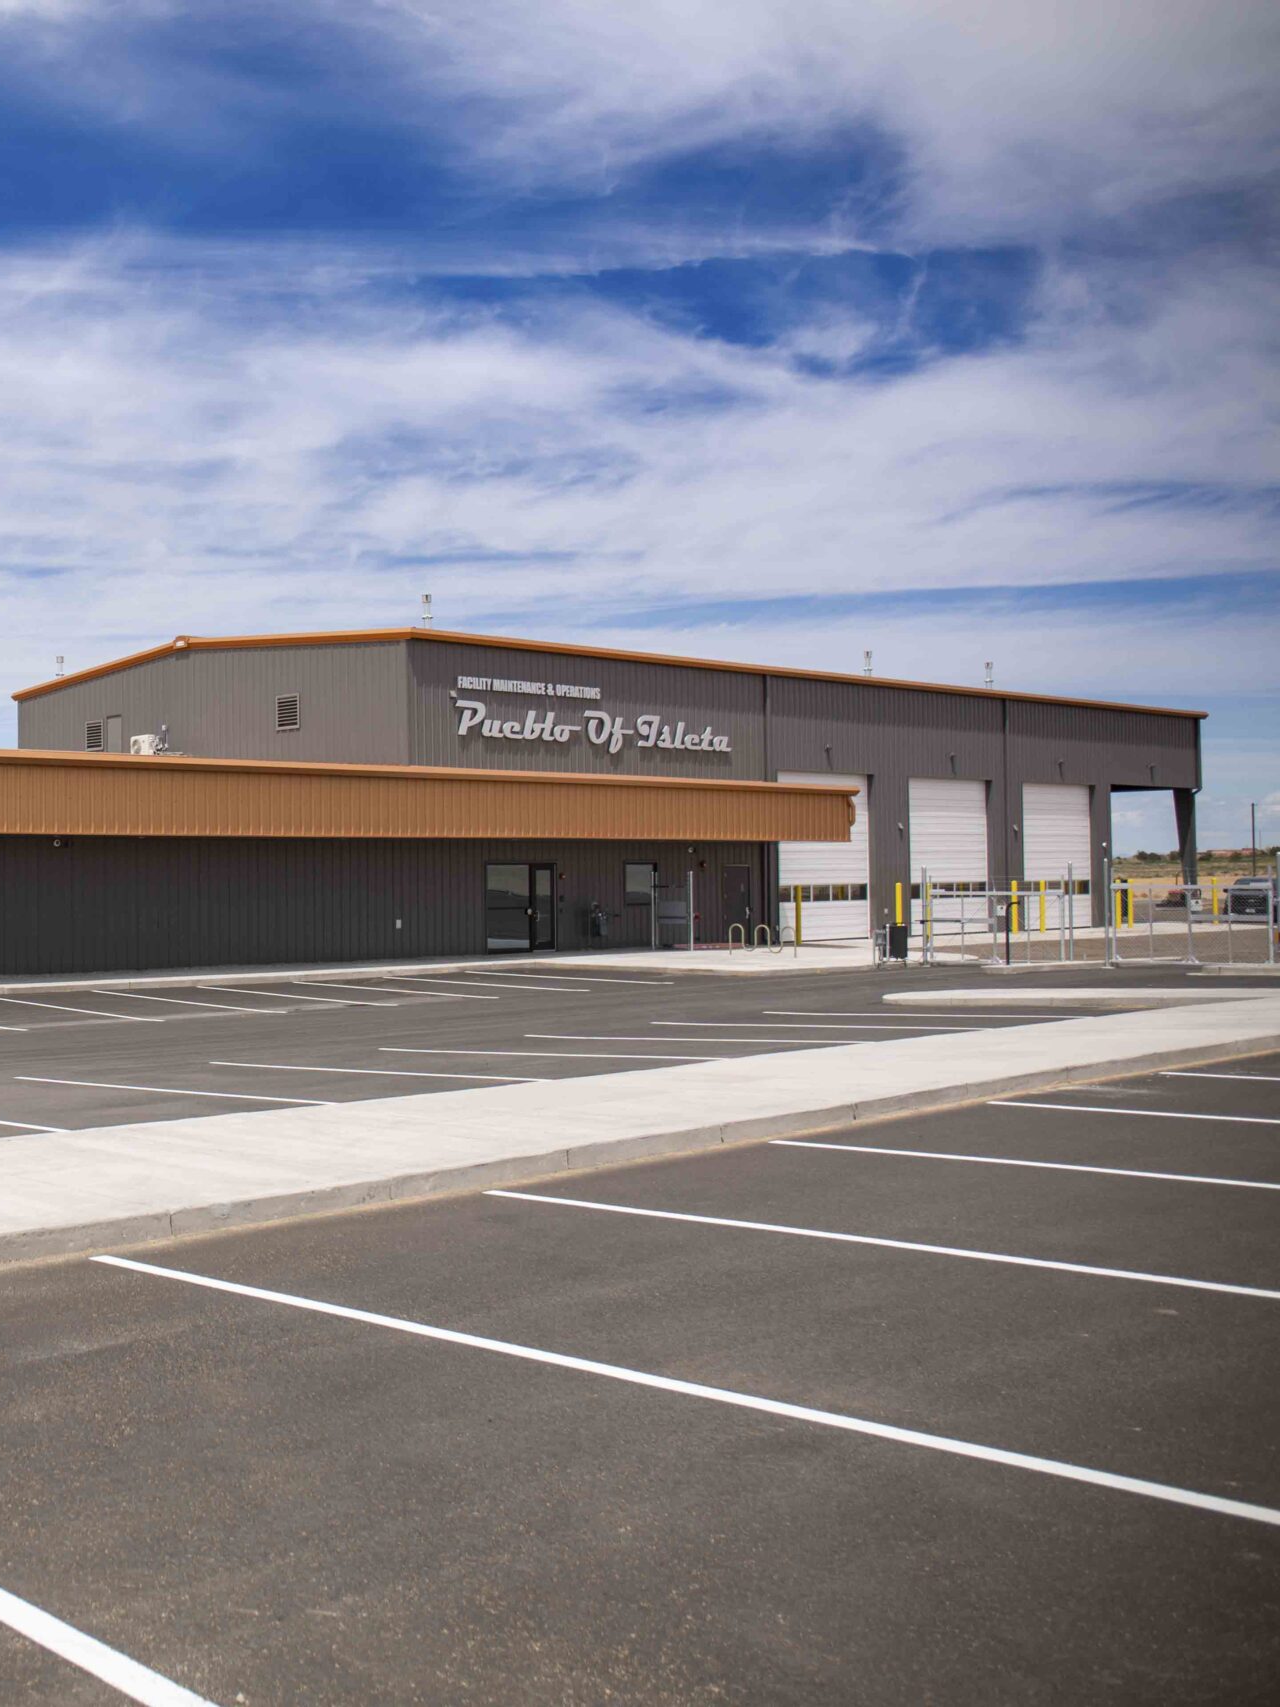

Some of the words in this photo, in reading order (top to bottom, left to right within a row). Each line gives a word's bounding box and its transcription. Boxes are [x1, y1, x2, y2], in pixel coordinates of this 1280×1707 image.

[457, 676, 492, 691] FACILITY
[492, 679, 546, 695] MAINTENANCE
[546, 683, 555, 696] &
[555, 684, 601, 700] OPERATIONS
[455, 699, 581, 742] Pueblo
[583, 710, 634, 754] Of
[636, 714, 732, 752] Isleta
